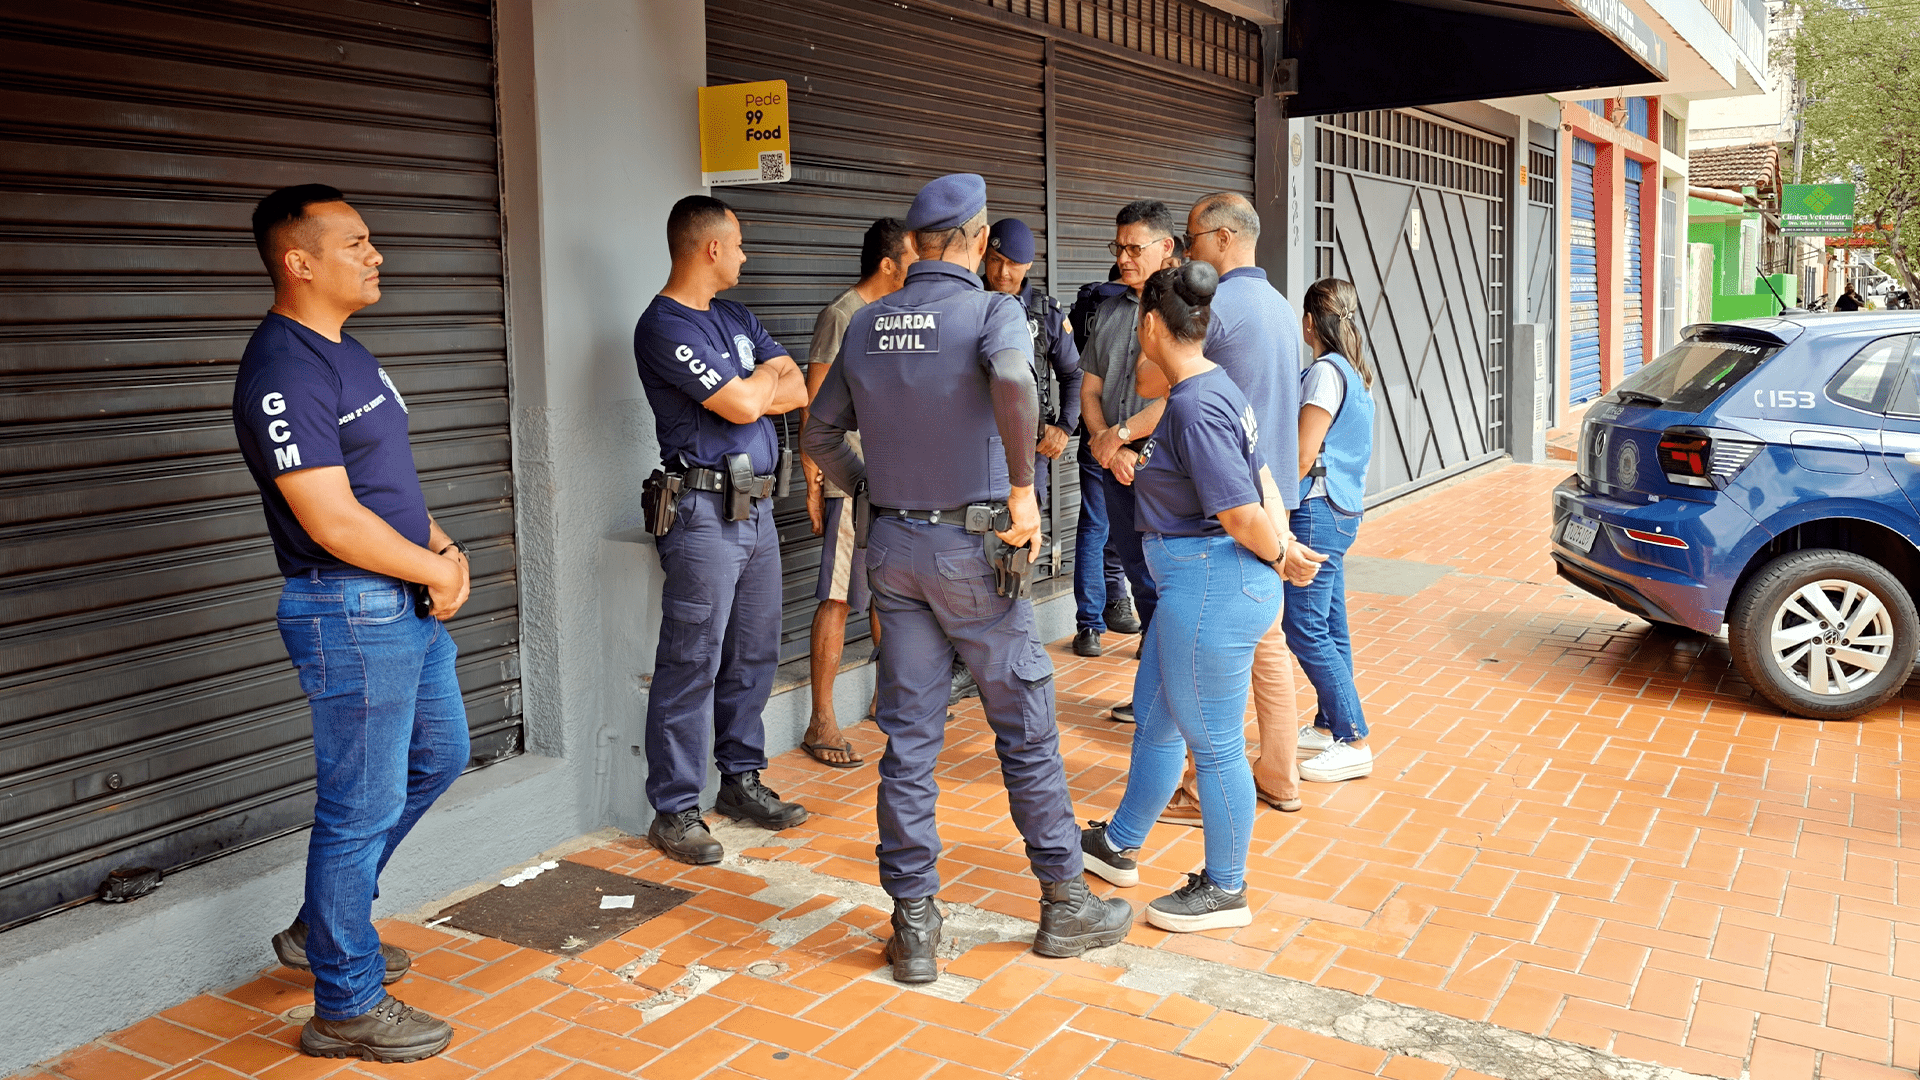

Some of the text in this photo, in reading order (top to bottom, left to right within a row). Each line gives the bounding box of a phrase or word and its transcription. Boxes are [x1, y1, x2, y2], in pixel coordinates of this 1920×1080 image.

[746, 92, 780, 107] Pede
[745, 110, 763, 125] 99
[746, 125, 781, 141] Food
[875, 314, 936, 331] GUARDA
[879, 334, 925, 350] CIVIL
[675, 345, 722, 390] GCM
[1770, 390, 1815, 409] 153
[262, 392, 301, 470] GCM
